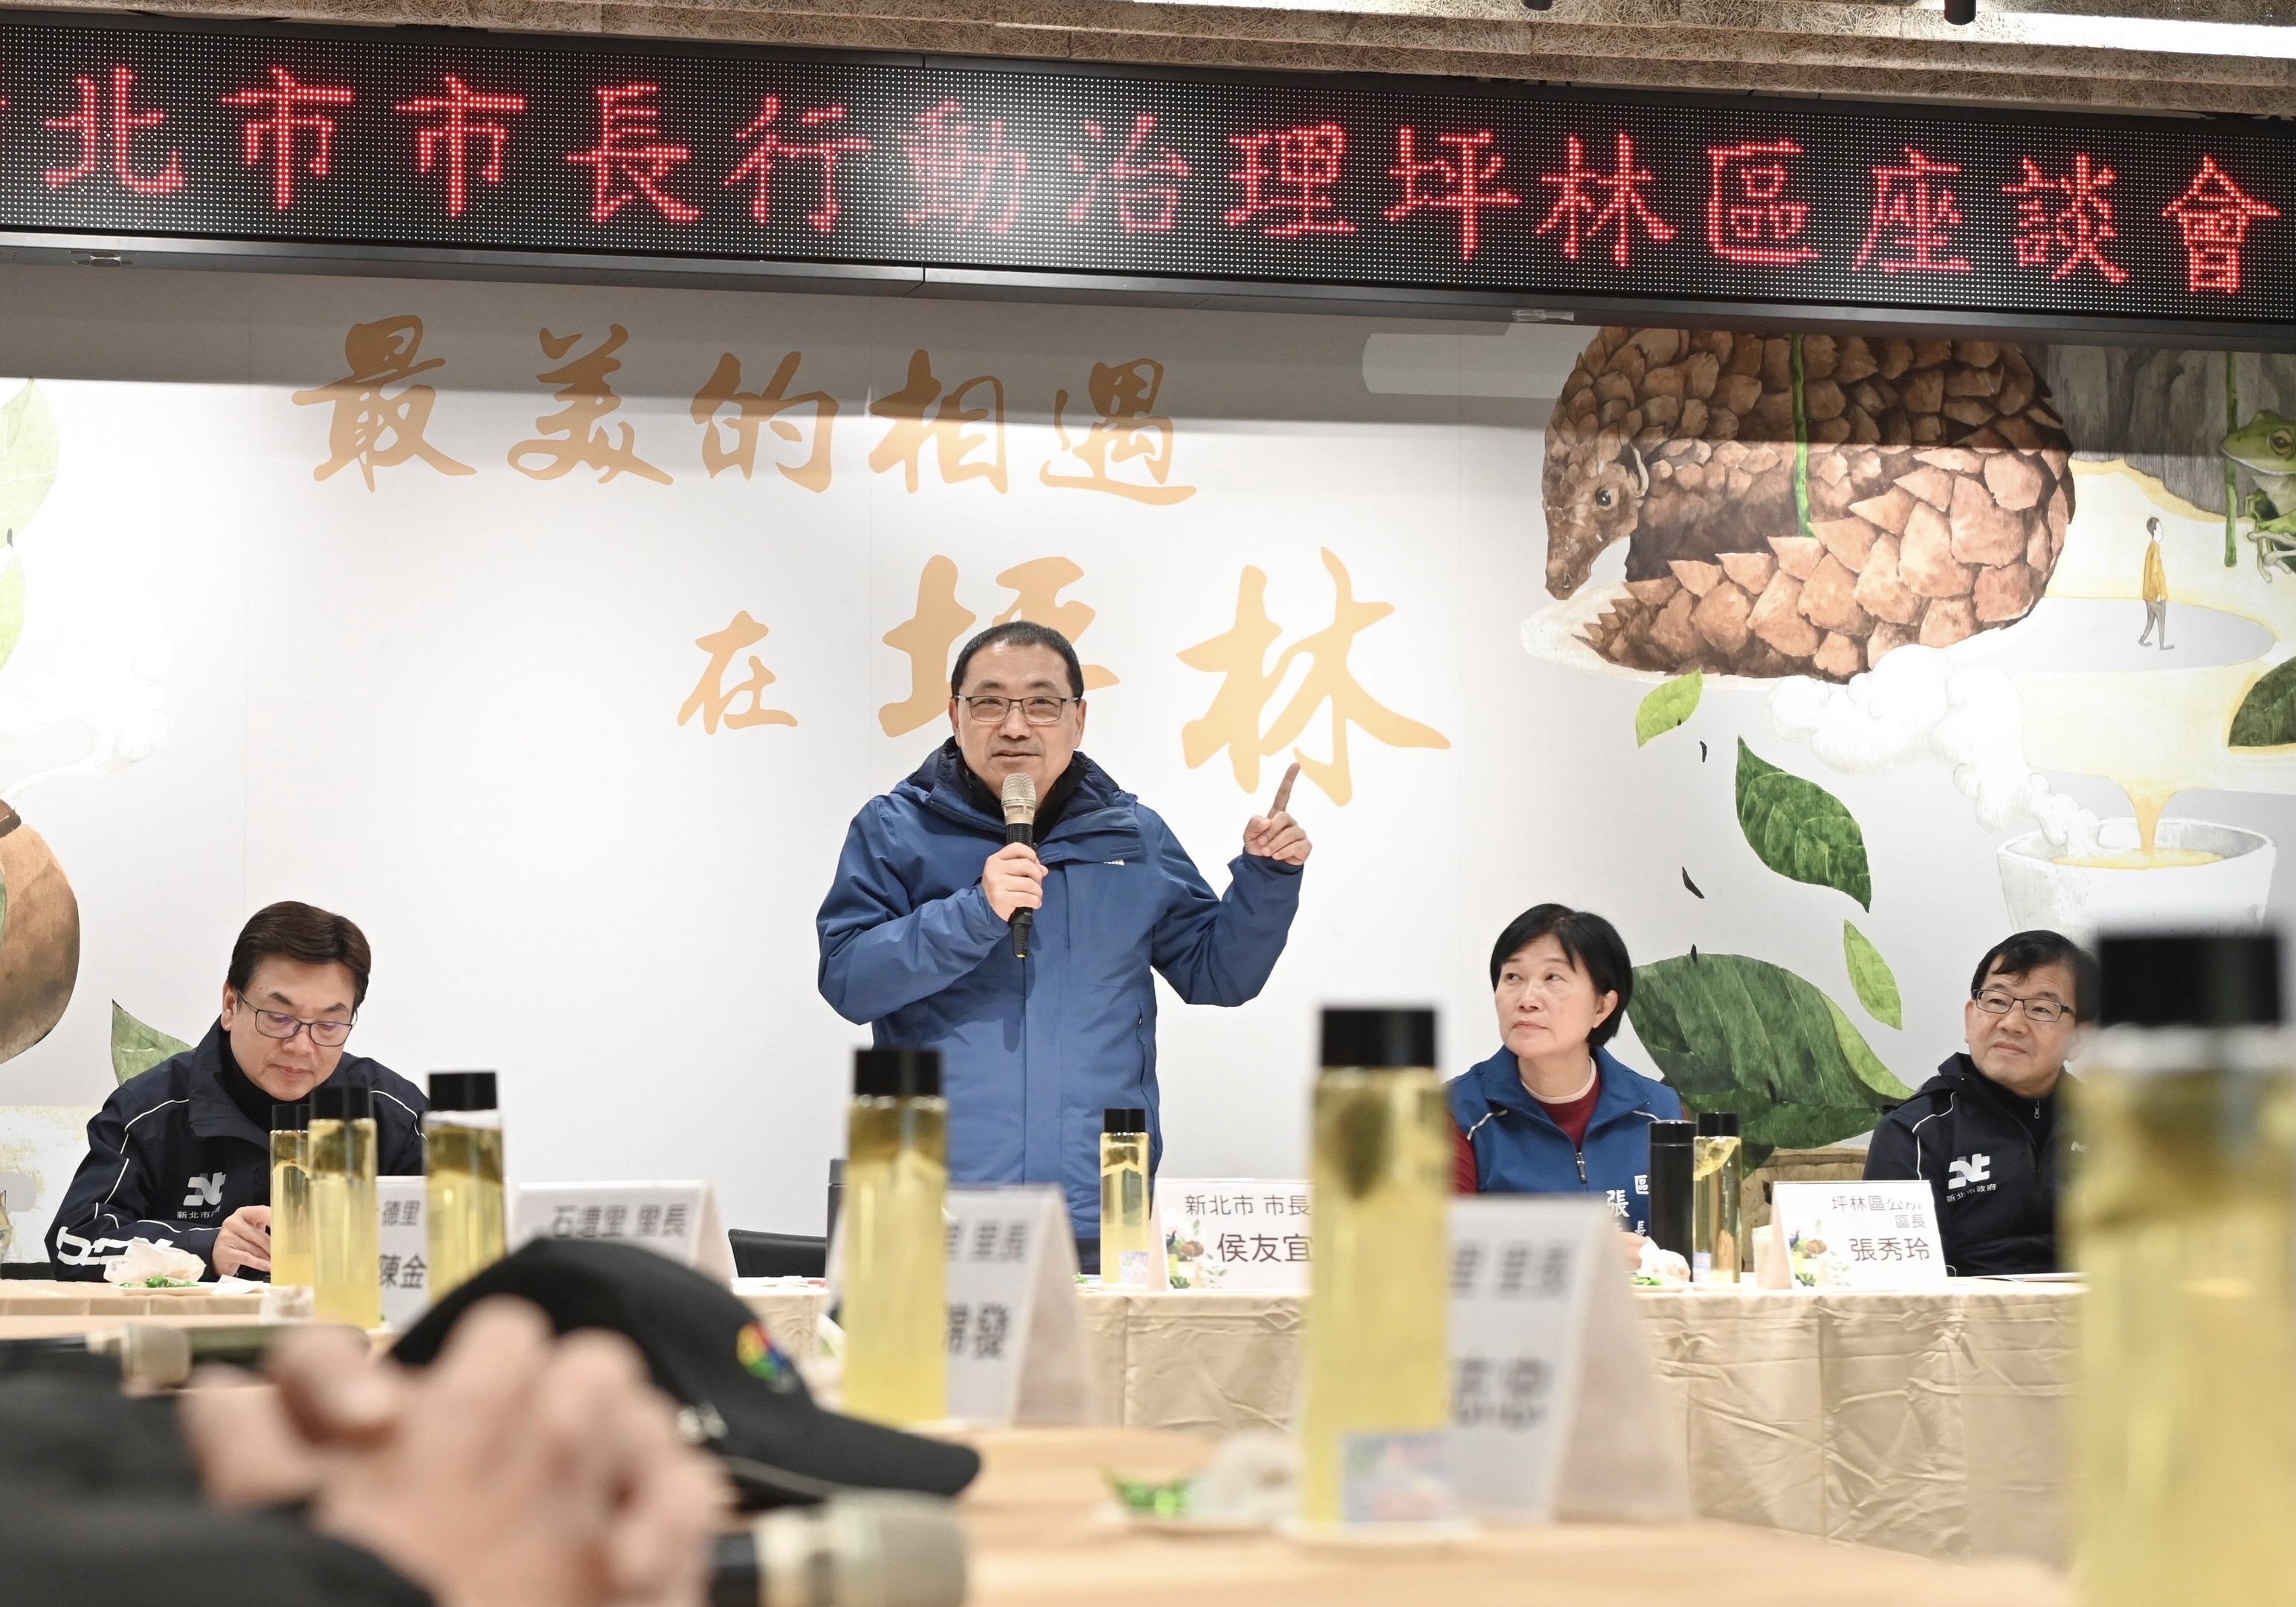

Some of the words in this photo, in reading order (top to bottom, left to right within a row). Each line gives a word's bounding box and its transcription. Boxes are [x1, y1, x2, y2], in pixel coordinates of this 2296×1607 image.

[0, 65, 2282, 295] 北市市長行動治理坪林區座談會
[291, 314, 1198, 506] 最美的相遇
[1184, 1194, 1254, 1216] 新北市
[1263, 1194, 1312, 1216] 市長
[1945, 1183, 1997, 1203] 新北市政府
[176, 1205, 221, 1219] 新北市
[381, 1200, 421, 1226] 德里
[1895, 1215, 1926, 1229] 區長
[1217, 1233, 1313, 1263] 侯友宜
[1849, 1237, 1930, 1261] 張秀玲
